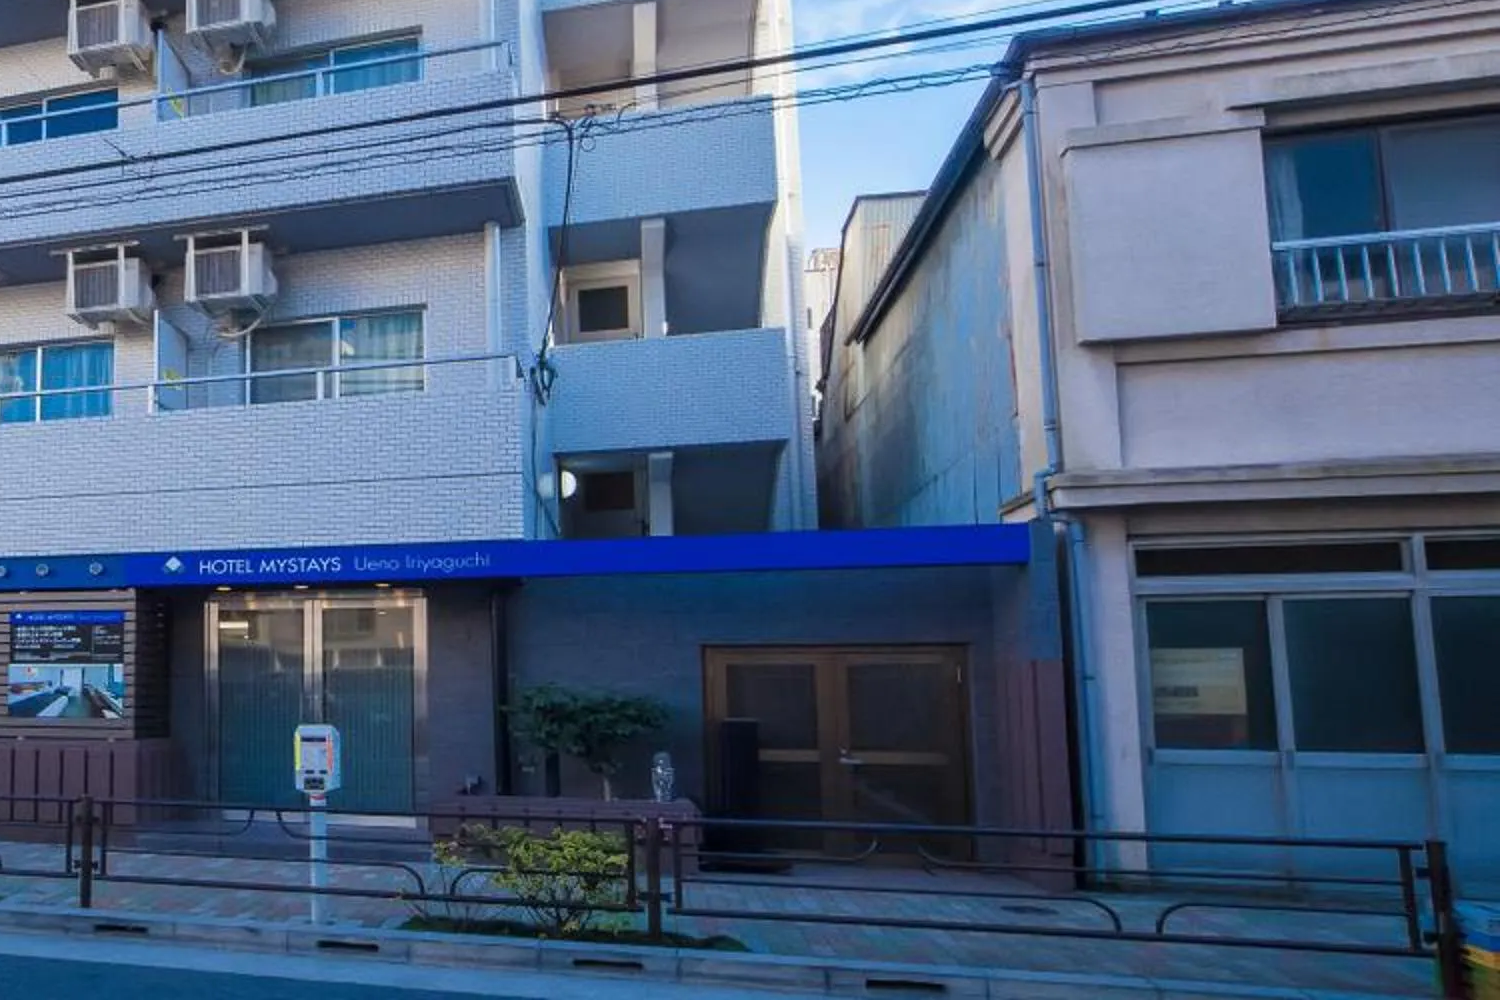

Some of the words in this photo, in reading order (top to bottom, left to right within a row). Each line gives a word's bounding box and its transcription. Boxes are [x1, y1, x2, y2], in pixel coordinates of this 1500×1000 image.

[199, 559, 254, 575] HOTEL
[259, 556, 341, 574] MYSTAYS
[353, 555, 400, 571] Ueno
[405, 551, 491, 573] Iriyaguchi
